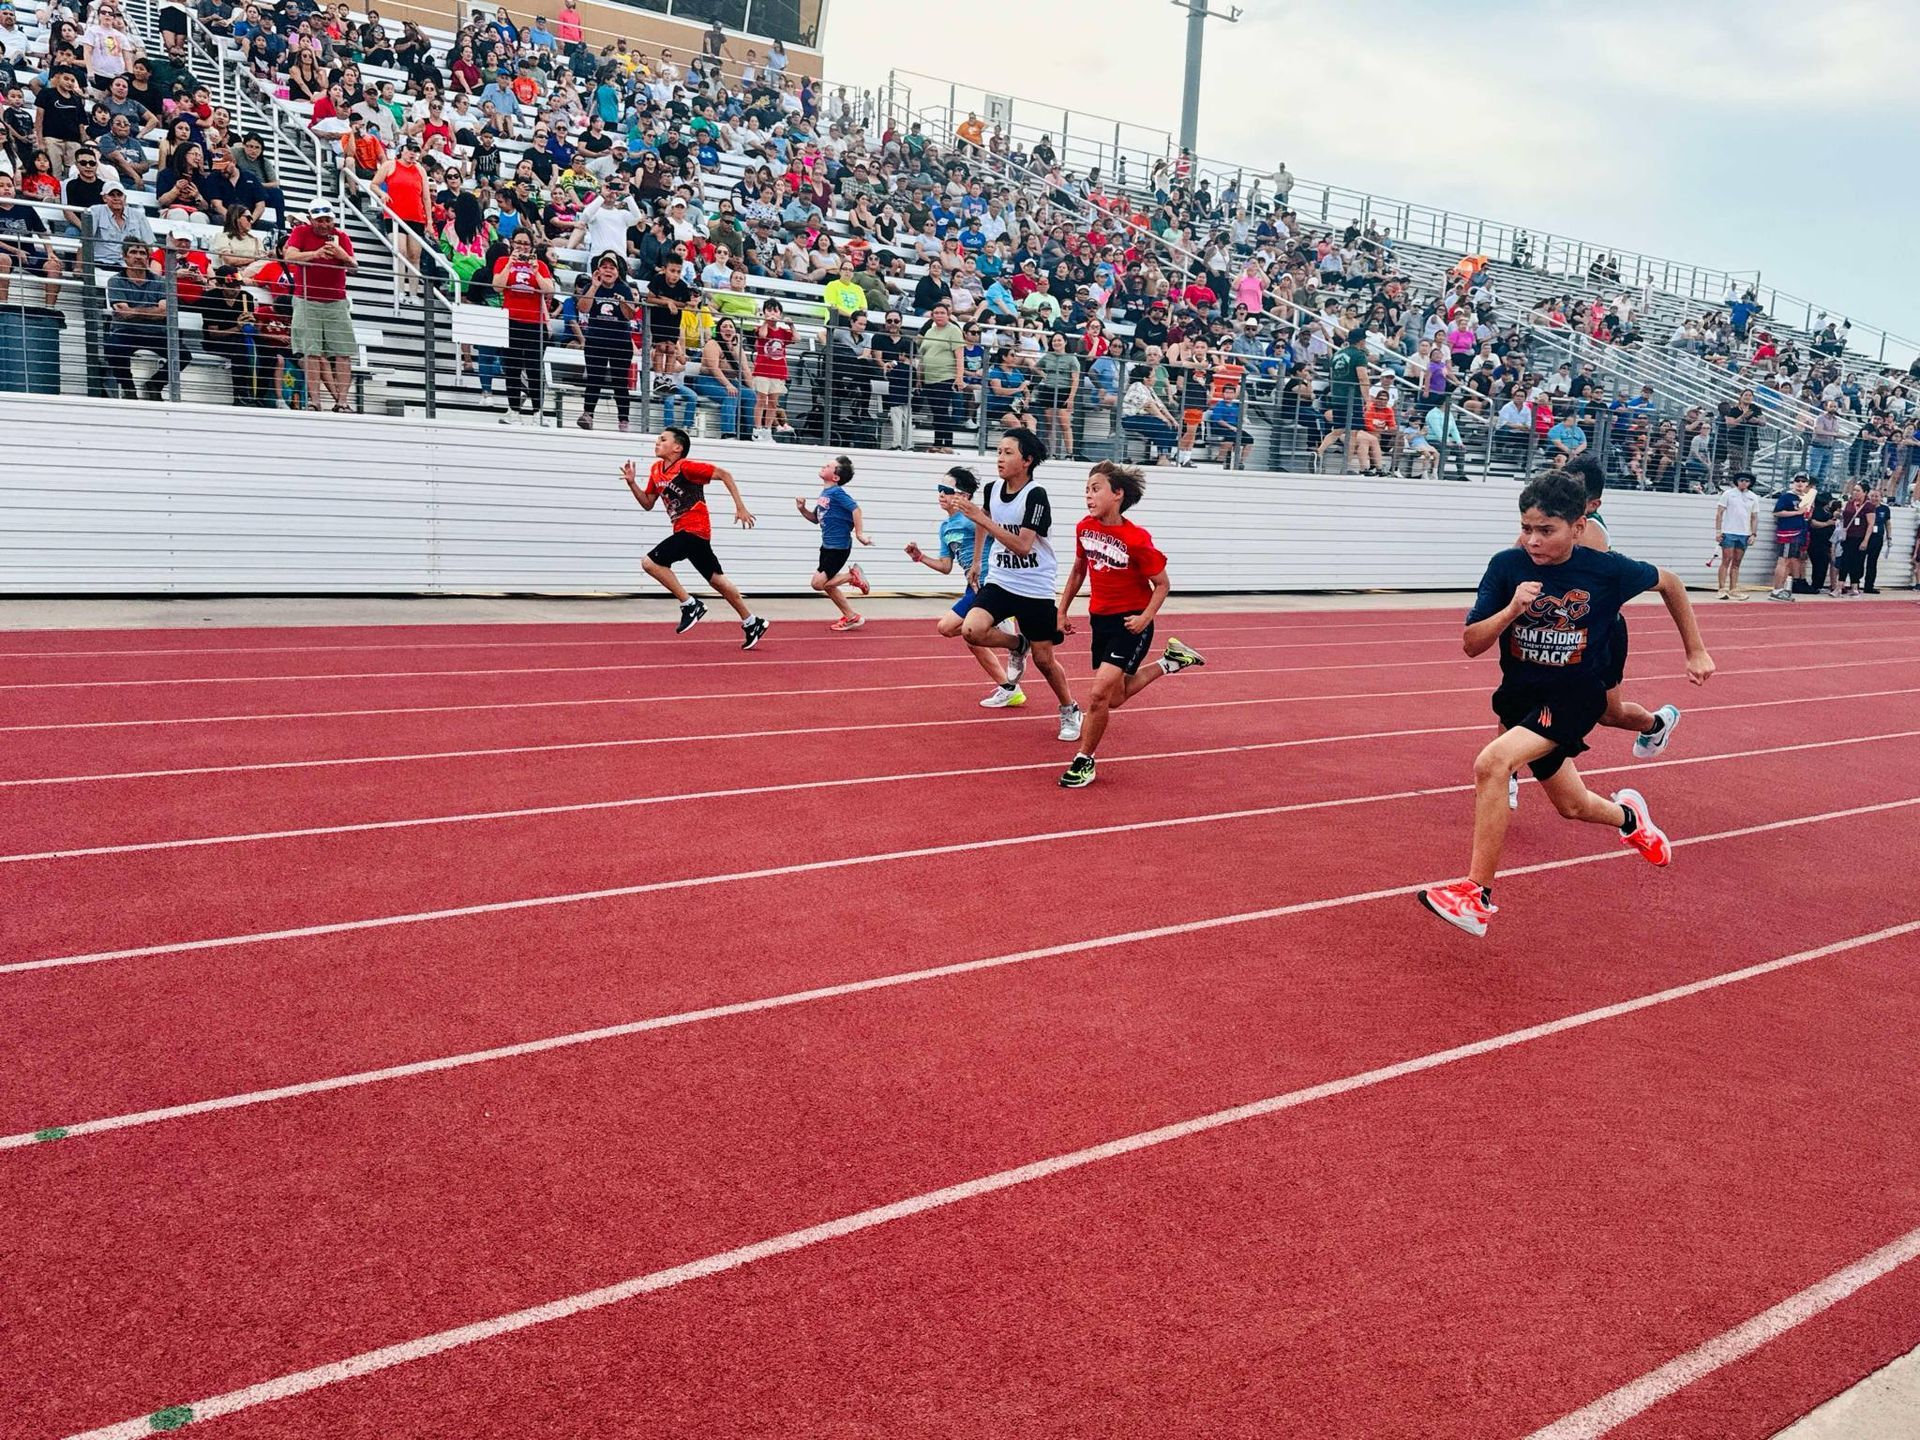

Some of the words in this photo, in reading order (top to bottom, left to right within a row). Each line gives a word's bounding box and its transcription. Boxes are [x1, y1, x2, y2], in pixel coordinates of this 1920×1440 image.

[1081, 529, 1128, 553] FALCONS
[996, 552, 1039, 569] TRACK
[1515, 627, 1538, 642] SAN
[1541, 631, 1582, 644] ISIDRO
[1518, 641, 1554, 650] ELEMENTARY
[1520, 647, 1570, 664] TRACK
